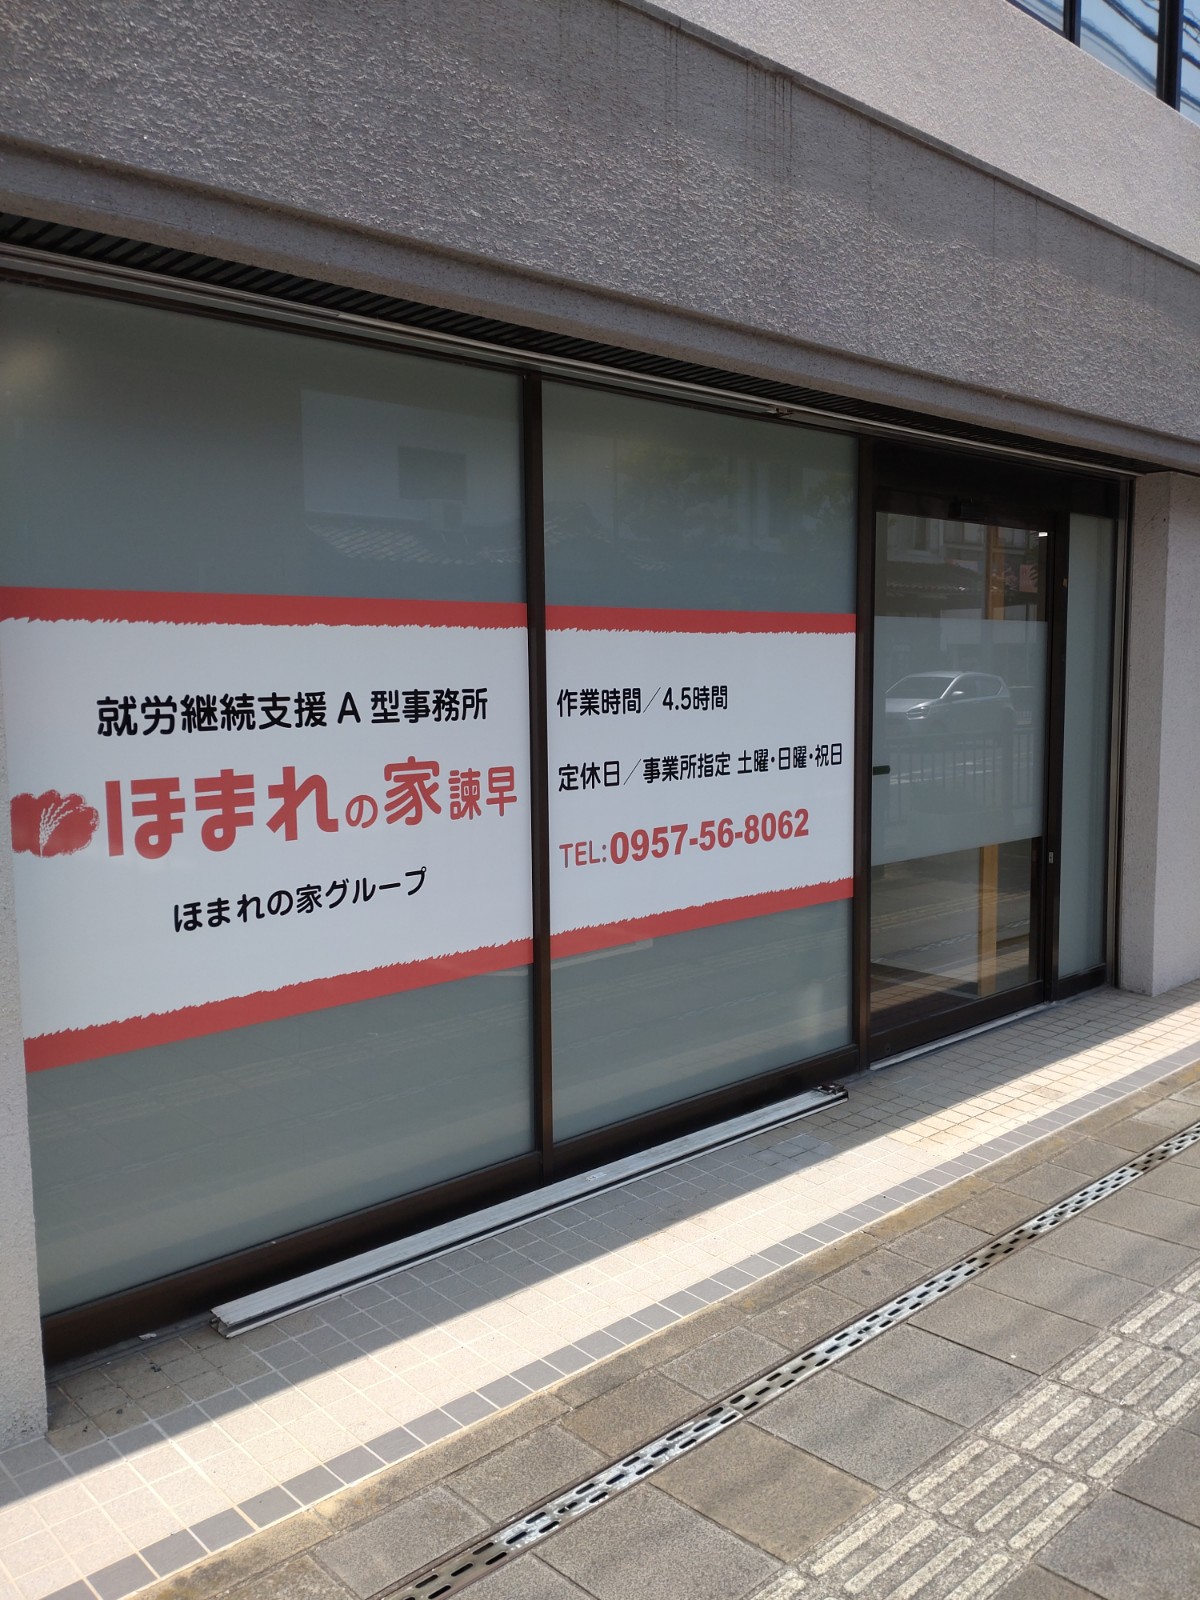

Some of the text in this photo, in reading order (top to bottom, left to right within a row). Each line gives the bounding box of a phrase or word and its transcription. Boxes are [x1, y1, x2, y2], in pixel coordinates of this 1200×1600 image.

[173, 866, 427, 933] ほまれの家グループ
